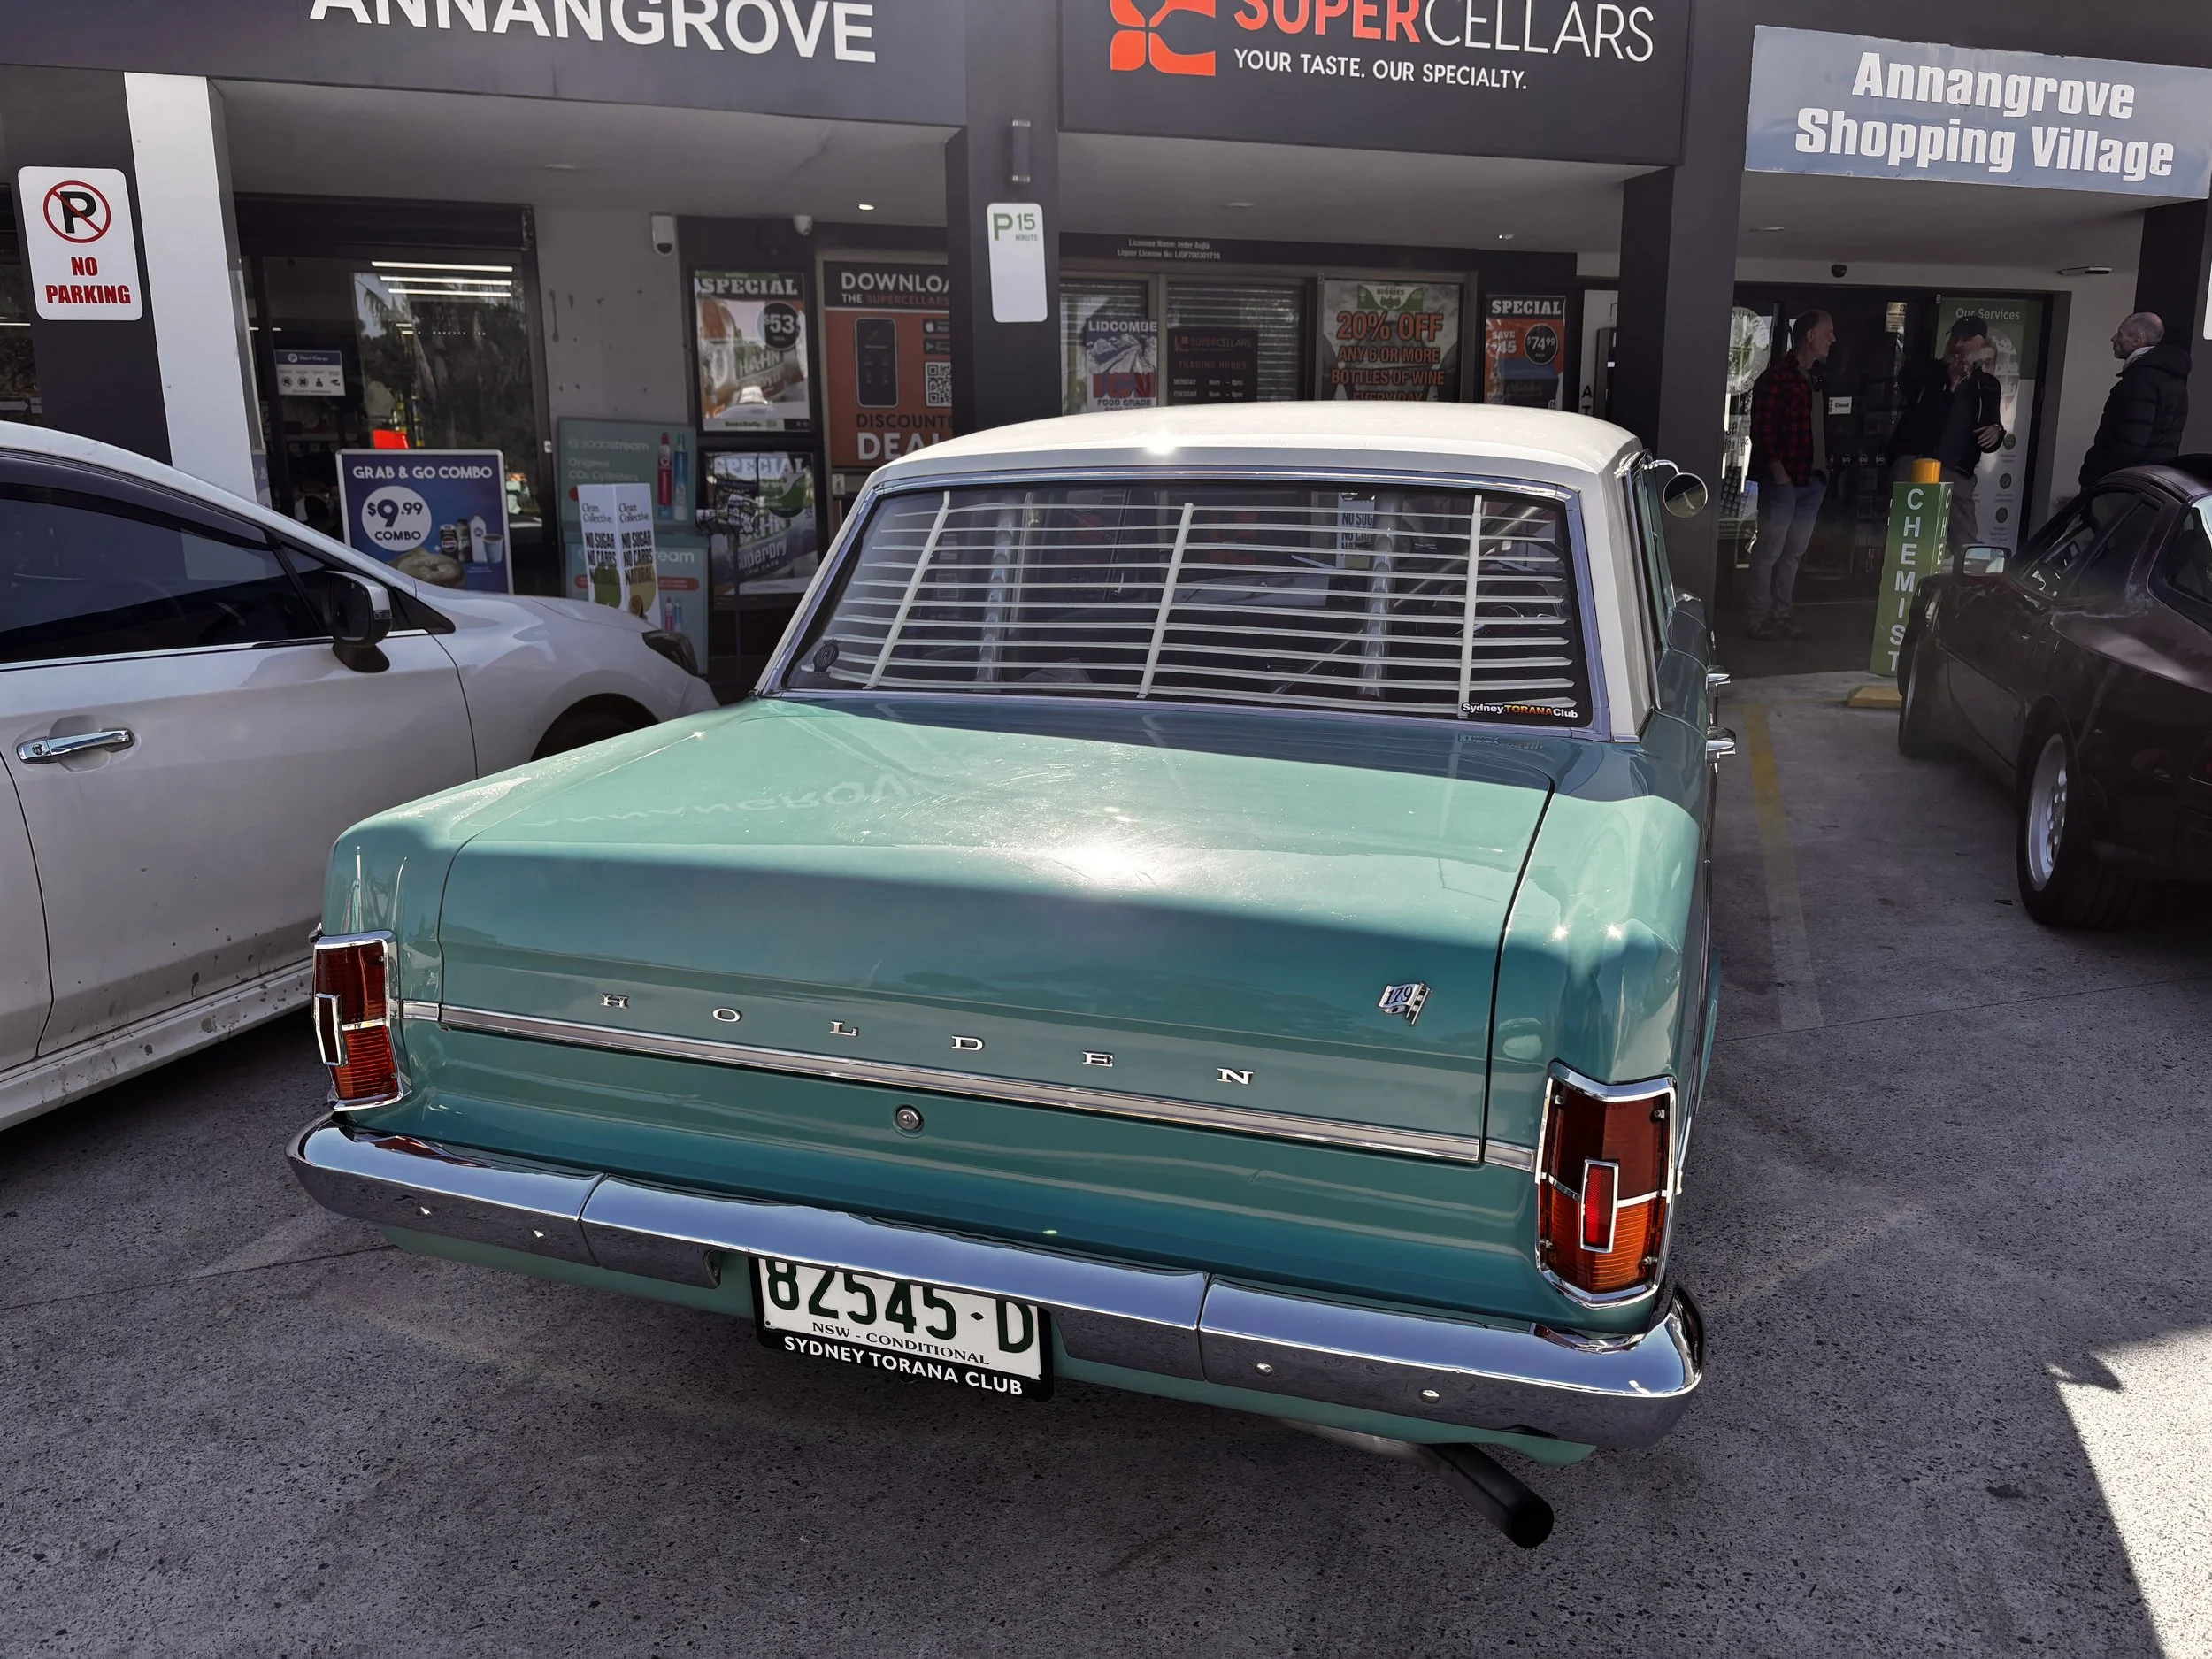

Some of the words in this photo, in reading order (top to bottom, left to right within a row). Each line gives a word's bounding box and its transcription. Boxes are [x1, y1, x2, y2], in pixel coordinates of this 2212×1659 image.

[1233, 0, 1655, 62] SUPERCELLARS
[1234, 48, 1292, 73] YOUR
[1301, 54, 1365, 78] TASTE.
[1373, 60, 1416, 81] OUR
[1423, 64, 1527, 89] SPECIALTY.
[1852, 51, 2136, 119] Annangrove
[1796, 107, 2016, 173] Shopping
[2032, 126, 2174, 182] Village
[993, 213, 1014, 241] P
[1017, 213, 1036, 231] 15
[71, 257, 99, 276] NO
[45, 285, 132, 304] PARKING
[703, 279, 798, 296] SPECIAL
[841, 293, 863, 303] THE
[867, 294, 949, 306] SUPERCELLARS
[1491, 299, 1561, 315] SPECIAL
[1978, 308, 2020, 320] Services
[1088, 320, 1157, 332] LIDCOMBE
[1337, 311, 1392, 341] 20%
[1398, 312, 1444, 342] OFF
[1338, 346, 1366, 363] ANY
[1369, 346, 1377, 363] 6
[1381, 347, 1400, 364] OR
[1402, 347, 1441, 364] MORE
[1332, 368, 1389, 385] BOTTLES
[1393, 370, 1409, 386] OF
[1413, 370, 1444, 386] WINE
[1353, 392, 1390, 401] EVERY
[1397, 392, 1424, 401] DAY
[353, 466, 395, 479] GRAB
[398, 466, 408, 478] &
[412, 467, 435, 479] GO
[439, 466, 493, 479] COMBO
[714, 457, 803, 475] SPECIAL
[367, 499, 423, 527] $9.99
[582, 503, 599, 512] Clean
[619, 503, 637, 512] Clean
[1341, 513, 1354, 526] NO
[374, 531, 421, 541] COMBO
[586, 533, 595, 549] NO
[595, 533, 615, 549] SUGAR
[621, 533, 631, 549] NO
[632, 530, 652, 548] SUGAR
[588, 550, 596, 566] NO
[623, 549, 633, 567] NO
[1888, 488, 1924, 672] CHEMIST
[1384, 986, 1412, 1005] 179
[812, 1321, 851, 1338] NSW
[865, 1332, 990, 1365] CONDITIONAL
[784, 1336, 864, 1363] SYDNEY
[868, 1352, 959, 1384] TORANA
[964, 1371, 1023, 1396] CLUB
